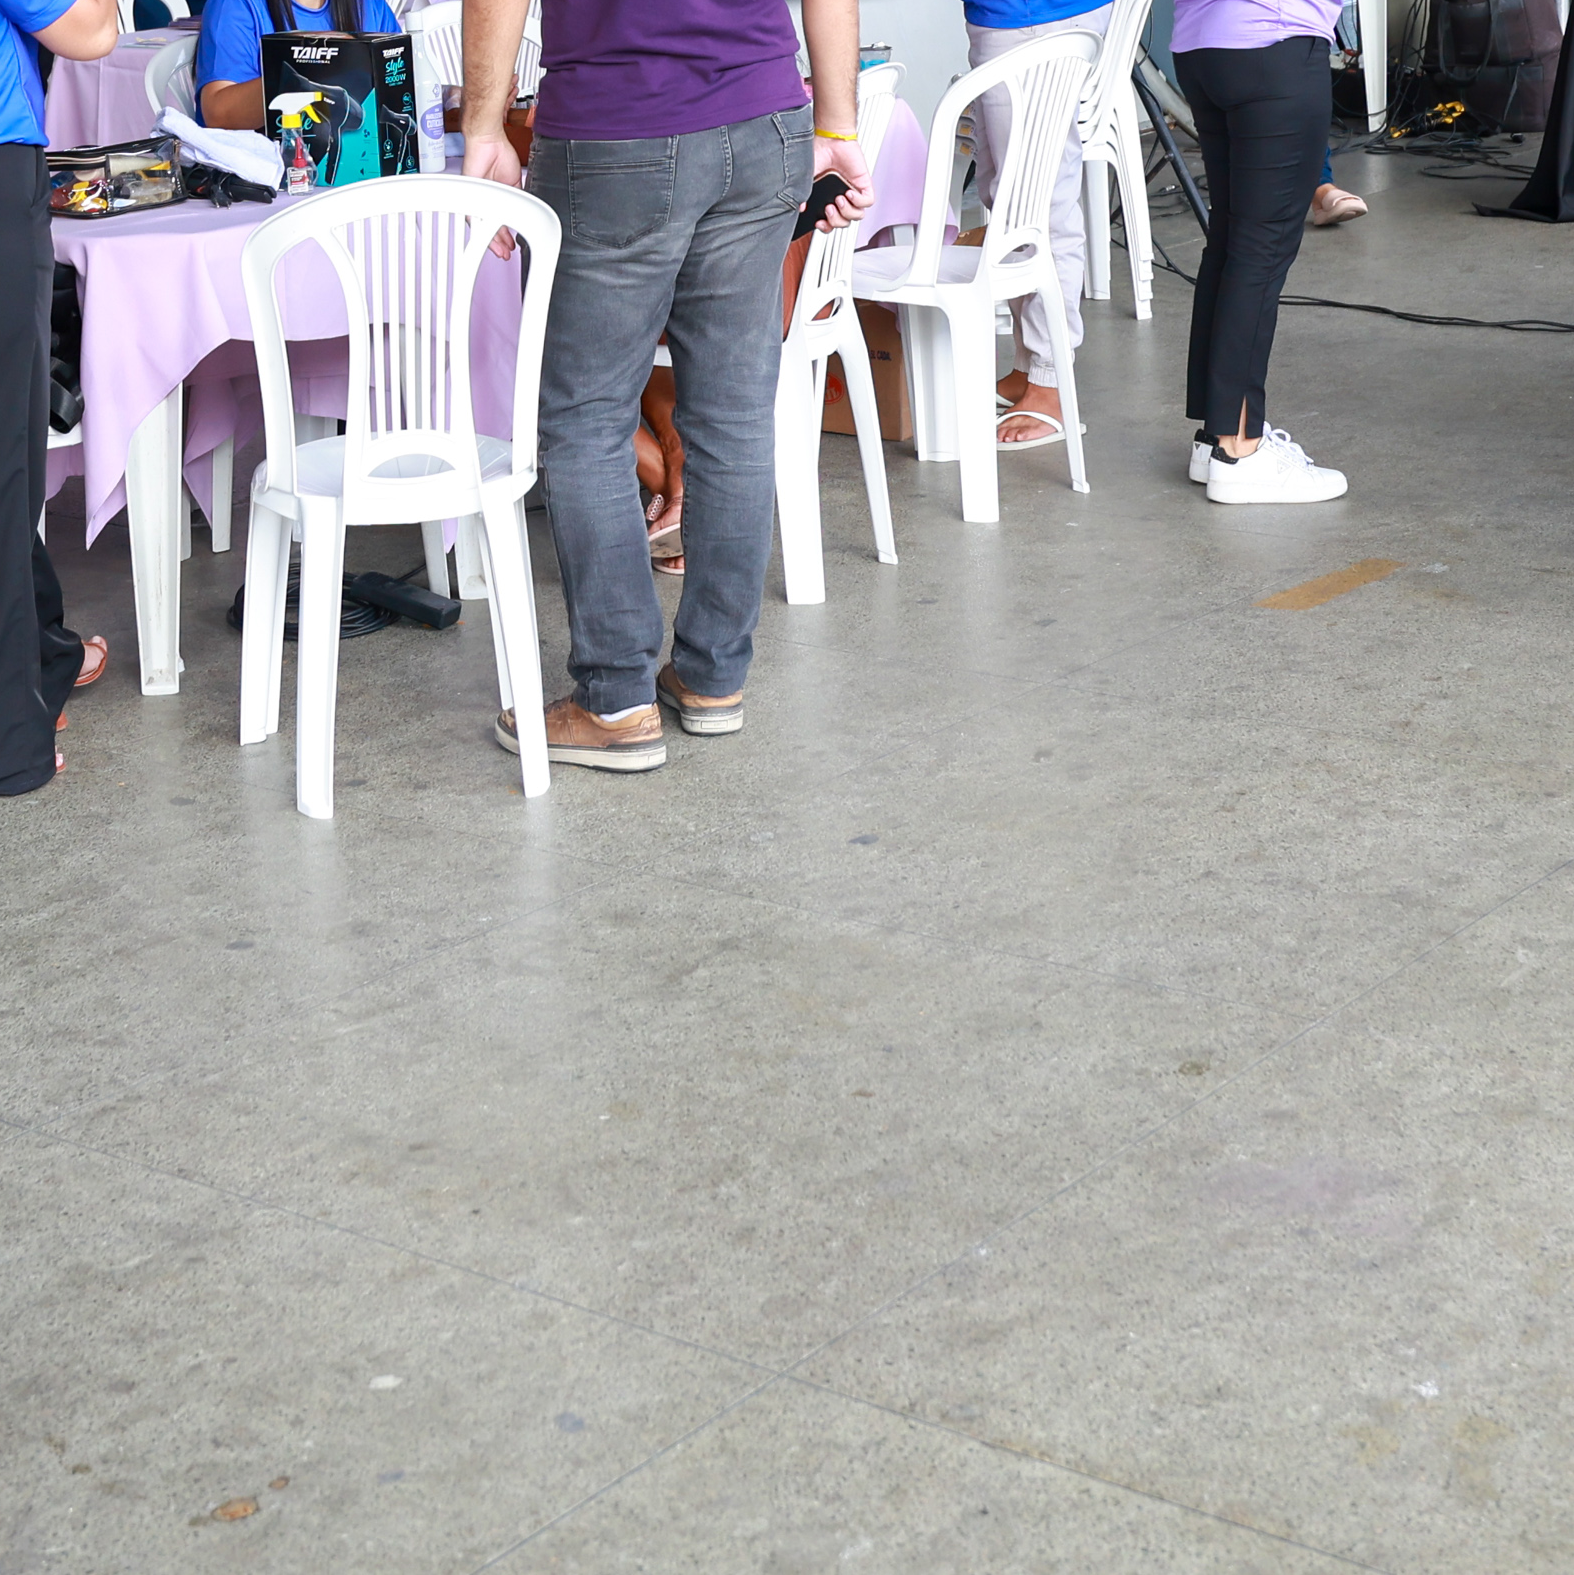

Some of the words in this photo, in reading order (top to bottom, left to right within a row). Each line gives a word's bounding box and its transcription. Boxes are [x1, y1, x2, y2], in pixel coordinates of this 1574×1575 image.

[291, 46, 339, 59] TAIFF
[382, 46, 405, 57] TAIFF
[386, 57, 404, 75] Style
